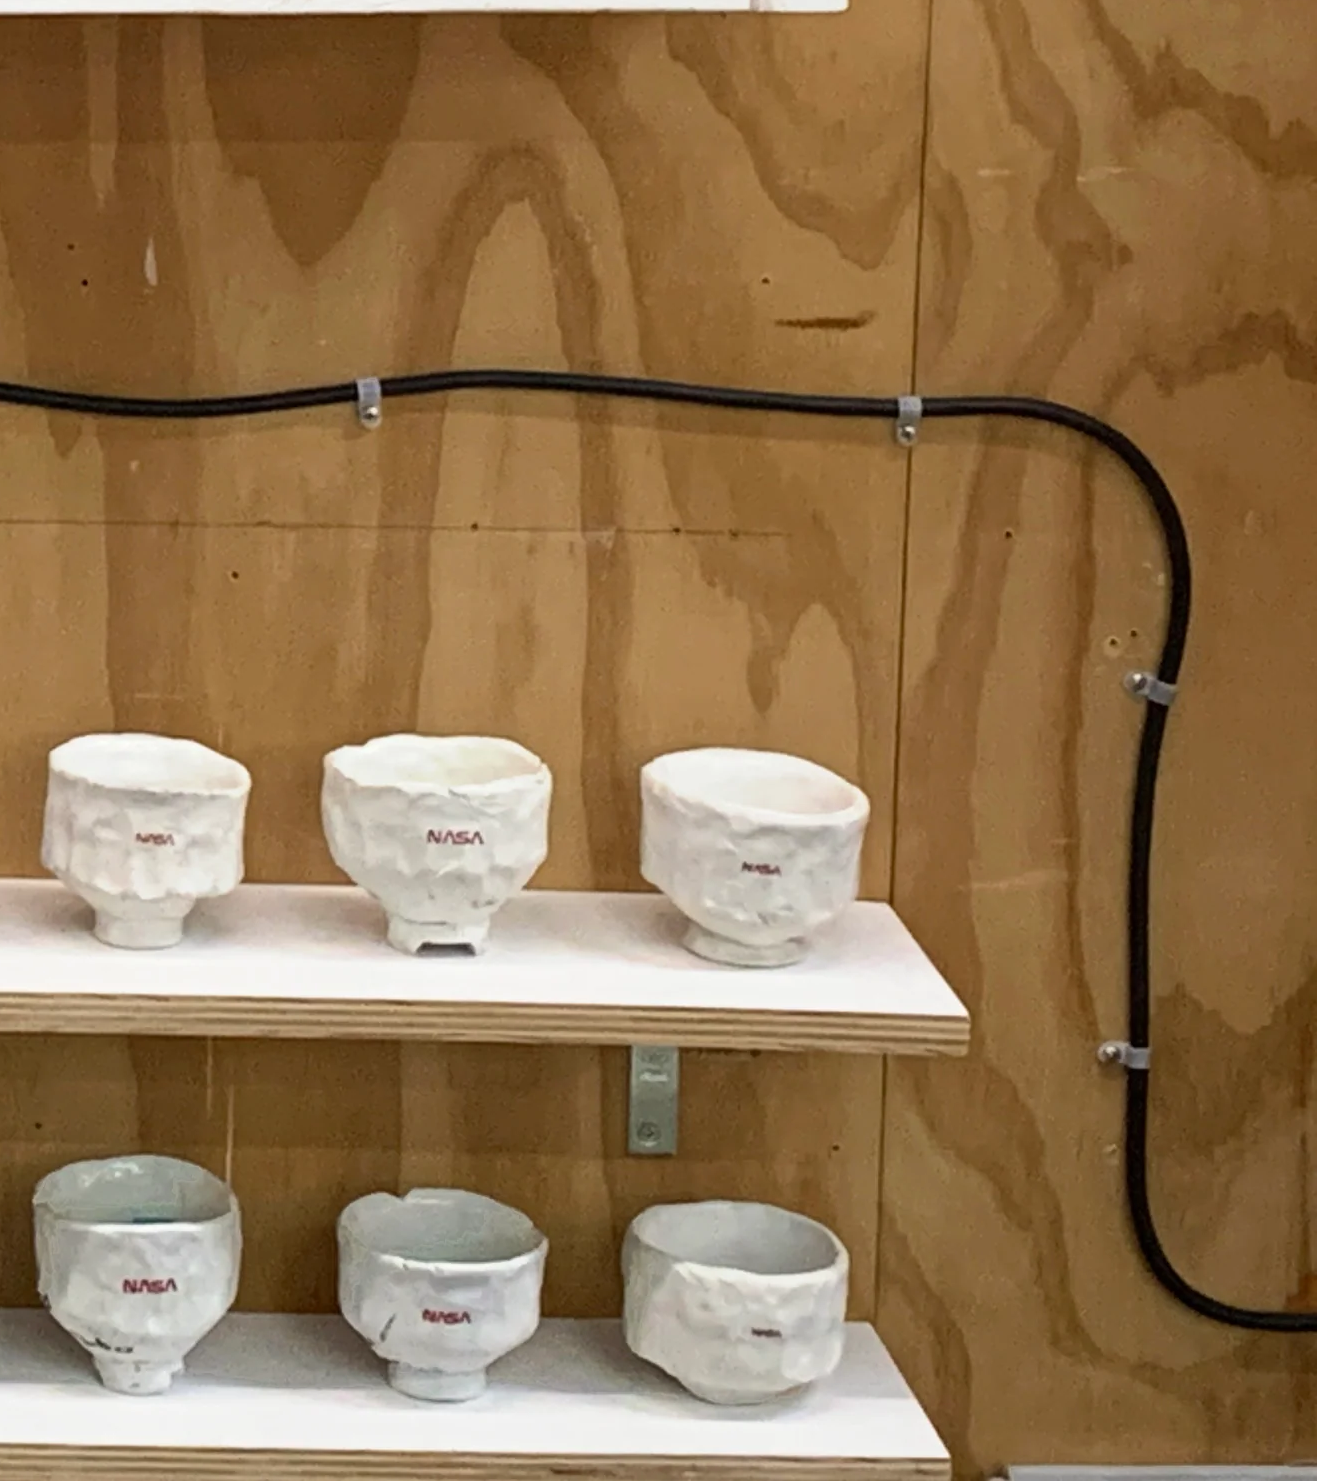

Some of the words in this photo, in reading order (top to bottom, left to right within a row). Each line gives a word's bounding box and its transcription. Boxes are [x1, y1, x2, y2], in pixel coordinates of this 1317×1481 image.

[135, 832, 175, 846] NASA
[426, 829, 485, 846] NASA
[741, 861, 782, 876] NASA
[122, 1277, 178, 1295] NASA
[421, 1308, 472, 1325] NASA
